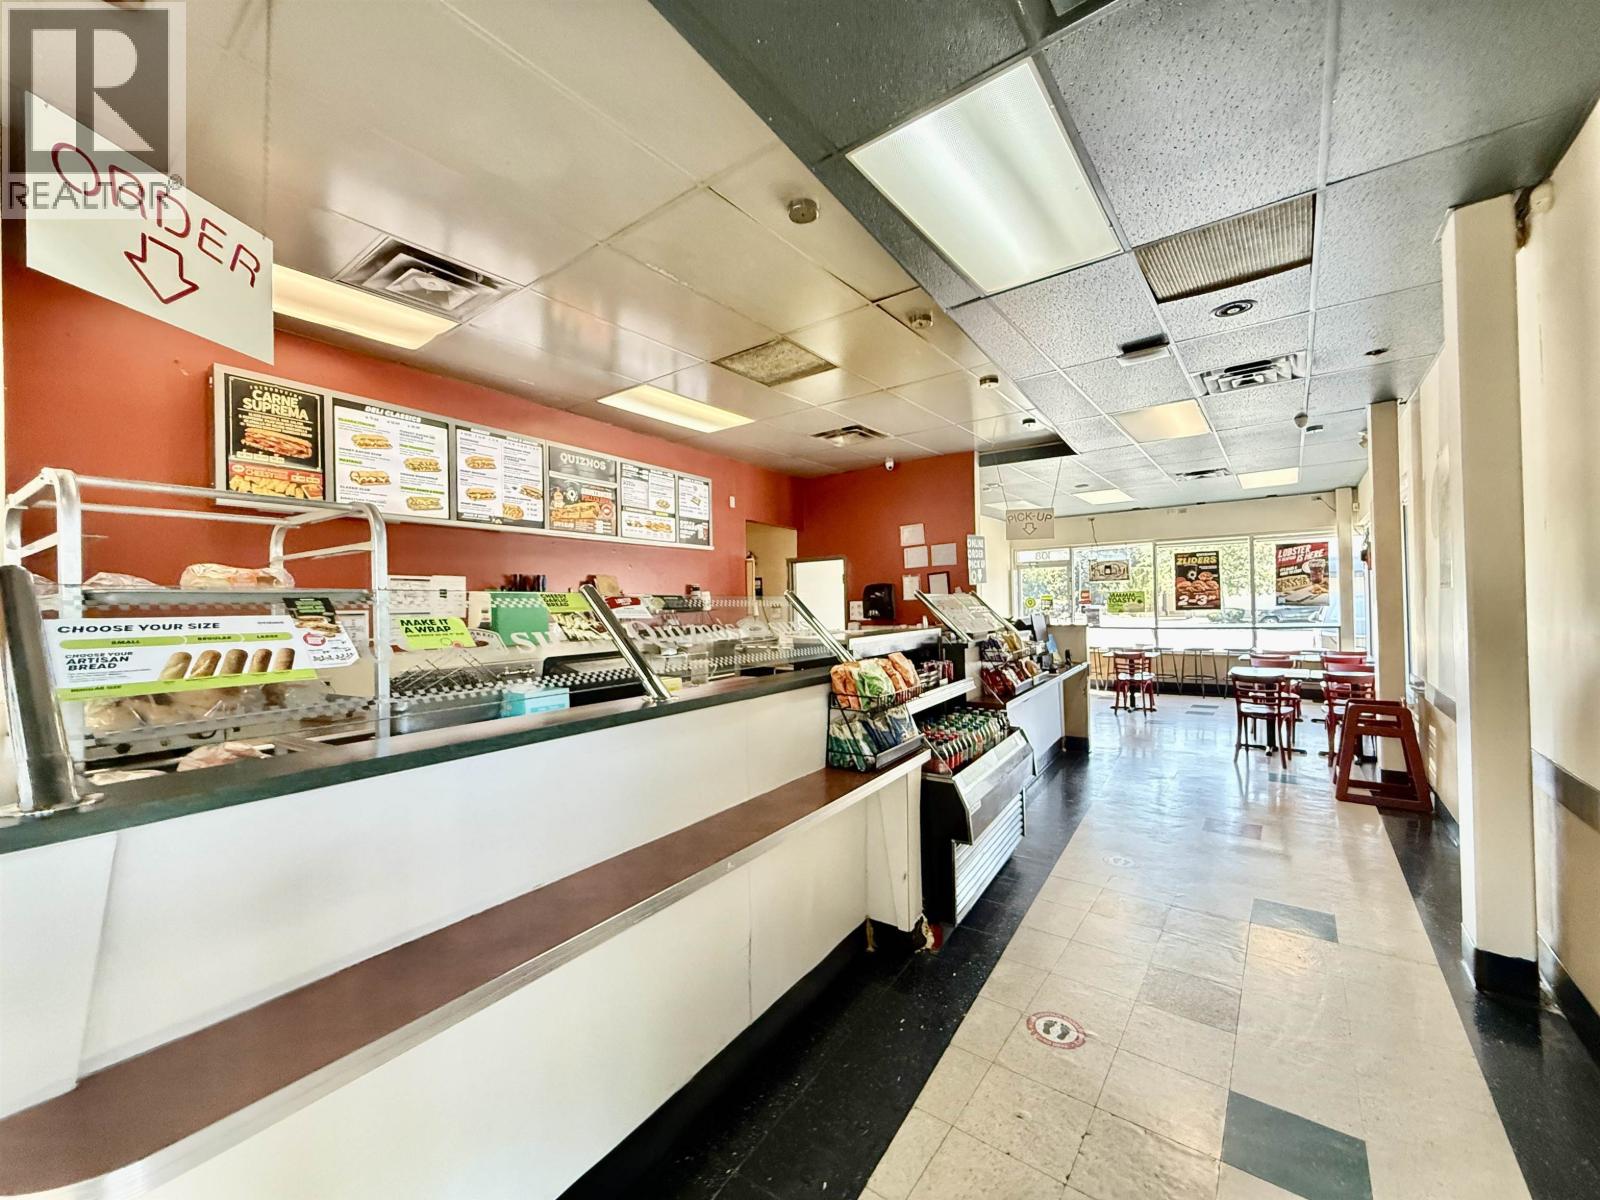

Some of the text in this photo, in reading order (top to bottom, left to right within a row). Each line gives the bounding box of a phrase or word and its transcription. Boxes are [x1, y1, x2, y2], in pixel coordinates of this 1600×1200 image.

[51, 142, 261, 288] ORDER
[252, 389, 299, 408] CARNE
[242, 397, 309, 421] SUPREMA
[365, 406, 384, 416] DELI
[385, 409, 422, 423] CLASSICS
[560, 452, 606, 470] QUIZNOS
[1007, 512, 1053, 524] PICK-UP
[1278, 544, 1312, 558] LOBSTER
[1176, 556, 1217, 565] ZLIDERS
[57, 624, 134, 633] CHOOSE
[139, 623, 183, 631] YOUR
[414, 625, 451, 633] WRAP
[66, 656, 129, 665] ARTISAN
[68, 662, 117, 671] BREAD
